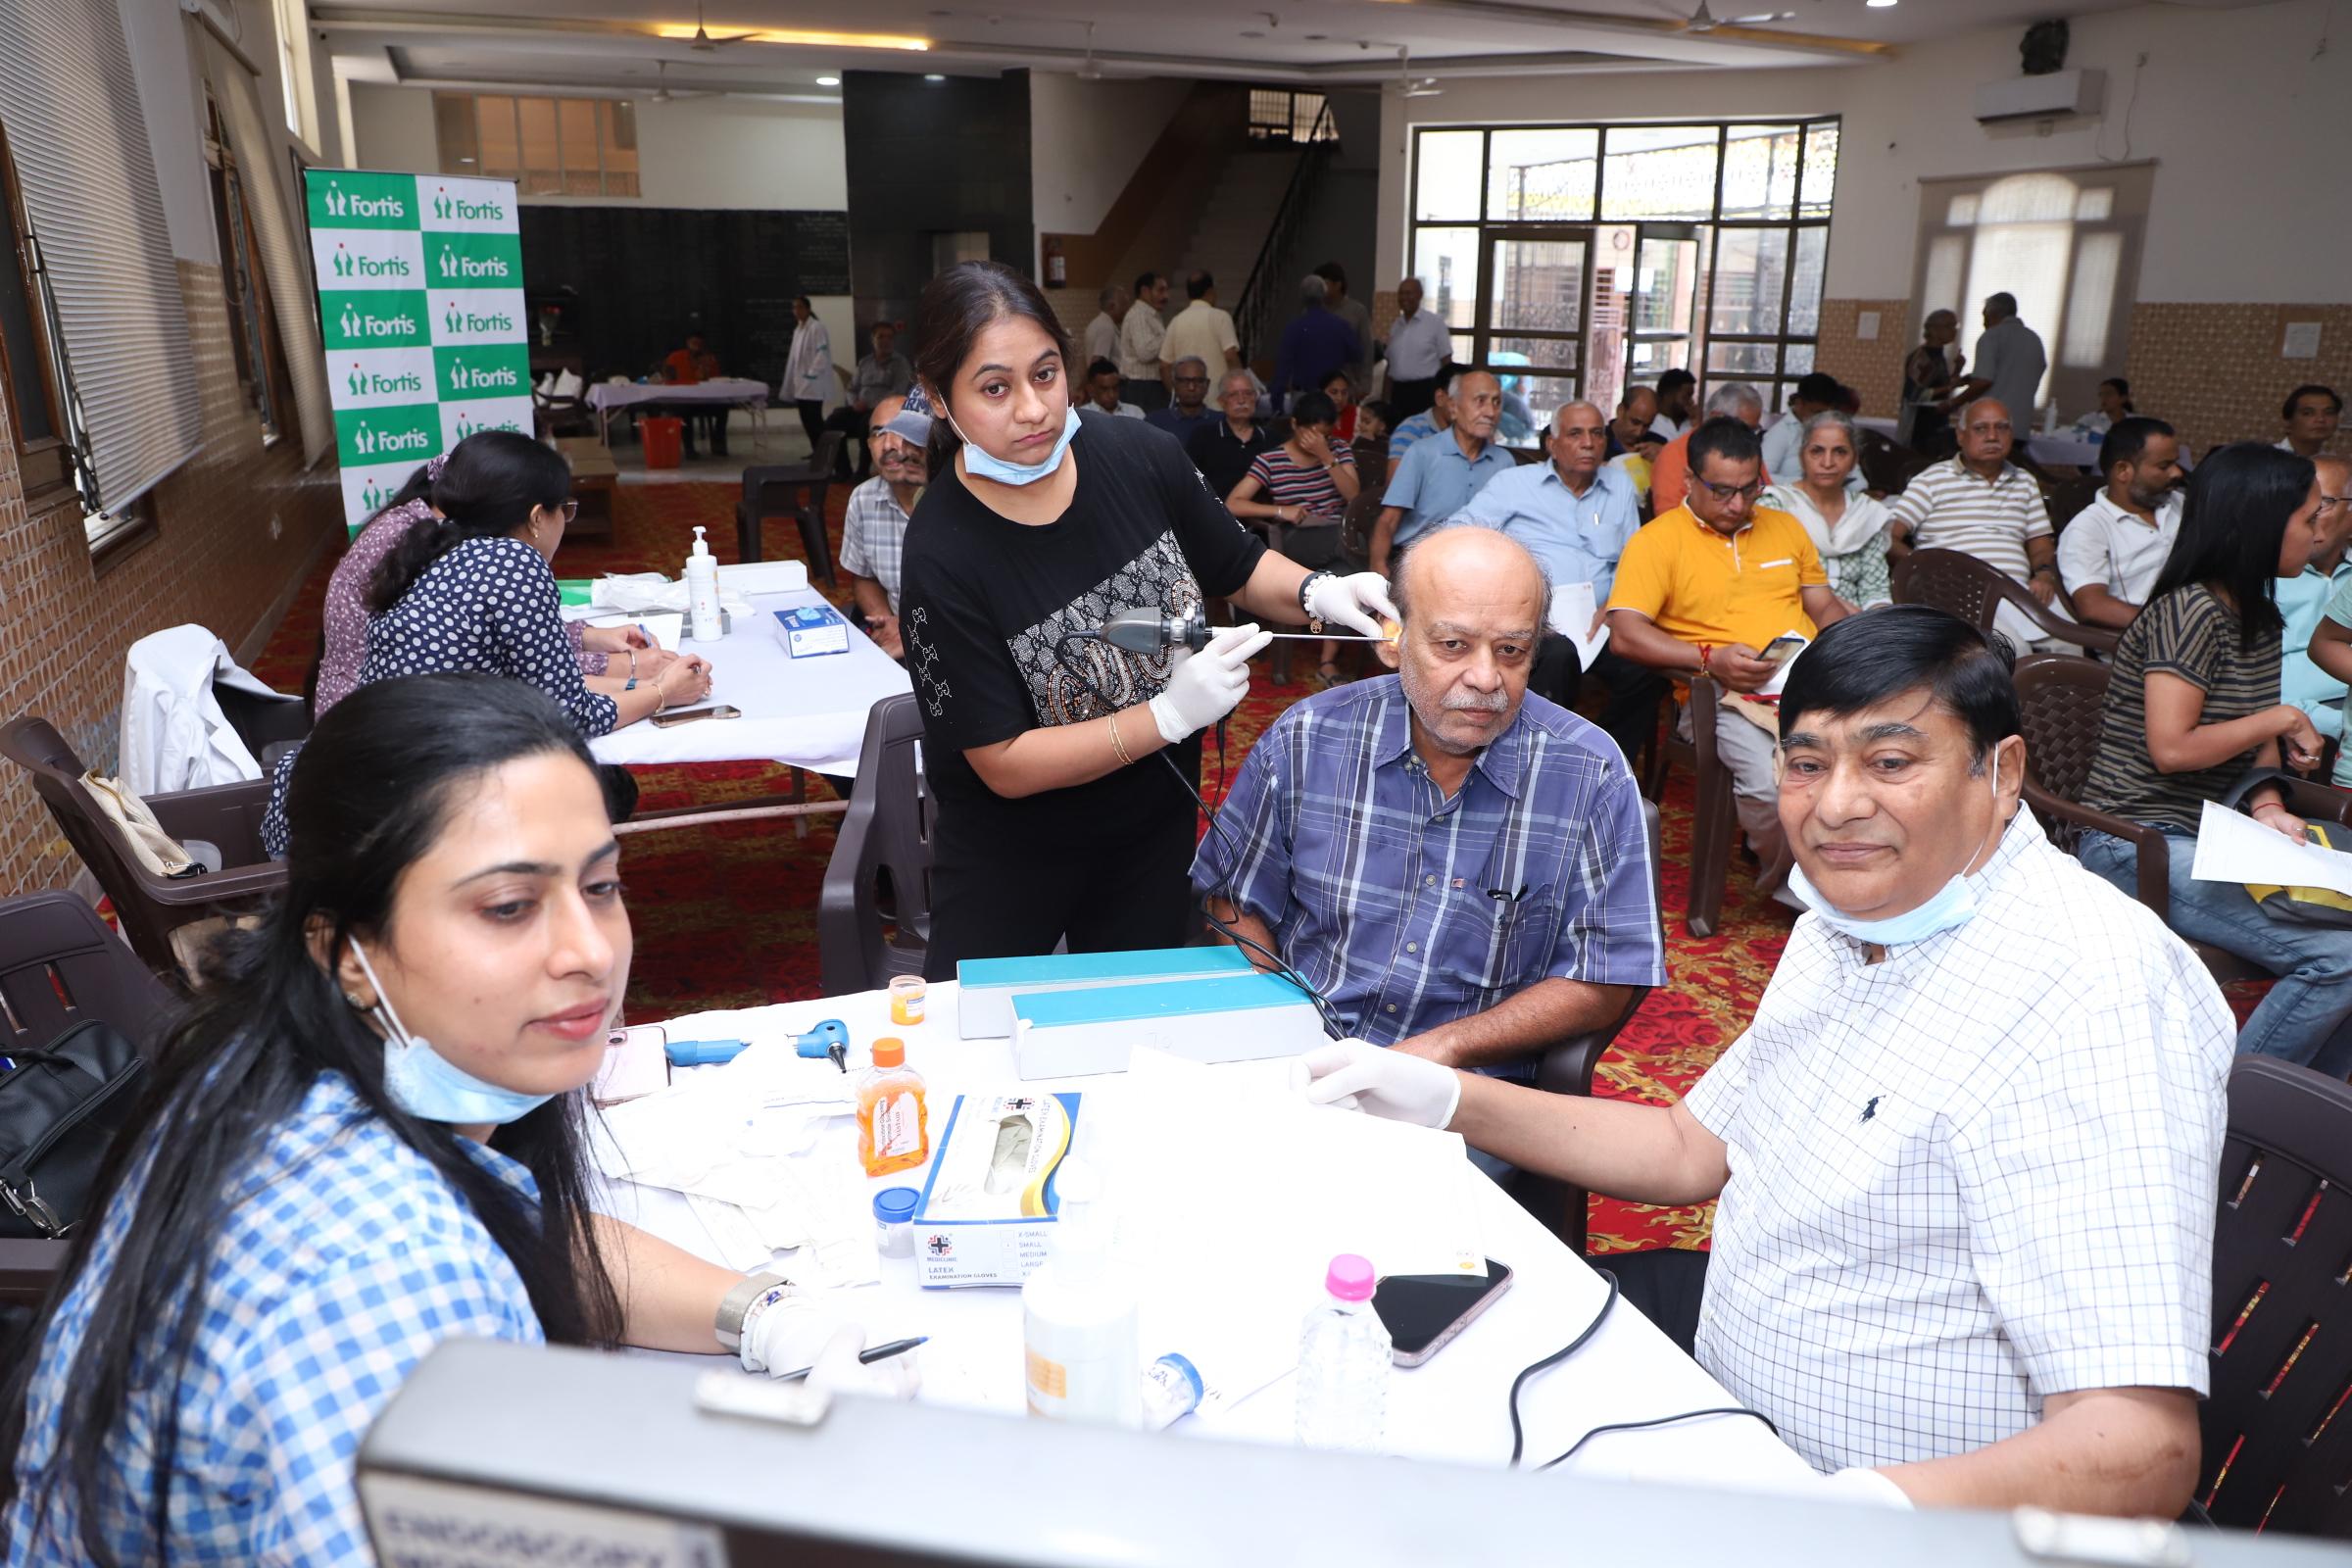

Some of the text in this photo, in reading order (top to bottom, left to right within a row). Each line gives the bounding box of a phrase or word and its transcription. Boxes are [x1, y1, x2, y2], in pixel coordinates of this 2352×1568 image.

[350, 195, 405, 218] Fortis
[457, 200, 503, 220] Fortis
[358, 256, 410, 276] Fortis
[462, 257, 509, 277] Fortis
[364, 314, 416, 336] Fortis
[466, 312, 513, 332] Fortis
[371, 371, 421, 393] Fortis
[470, 366, 517, 388] Fortis
[377, 427, 428, 451] Fortis
